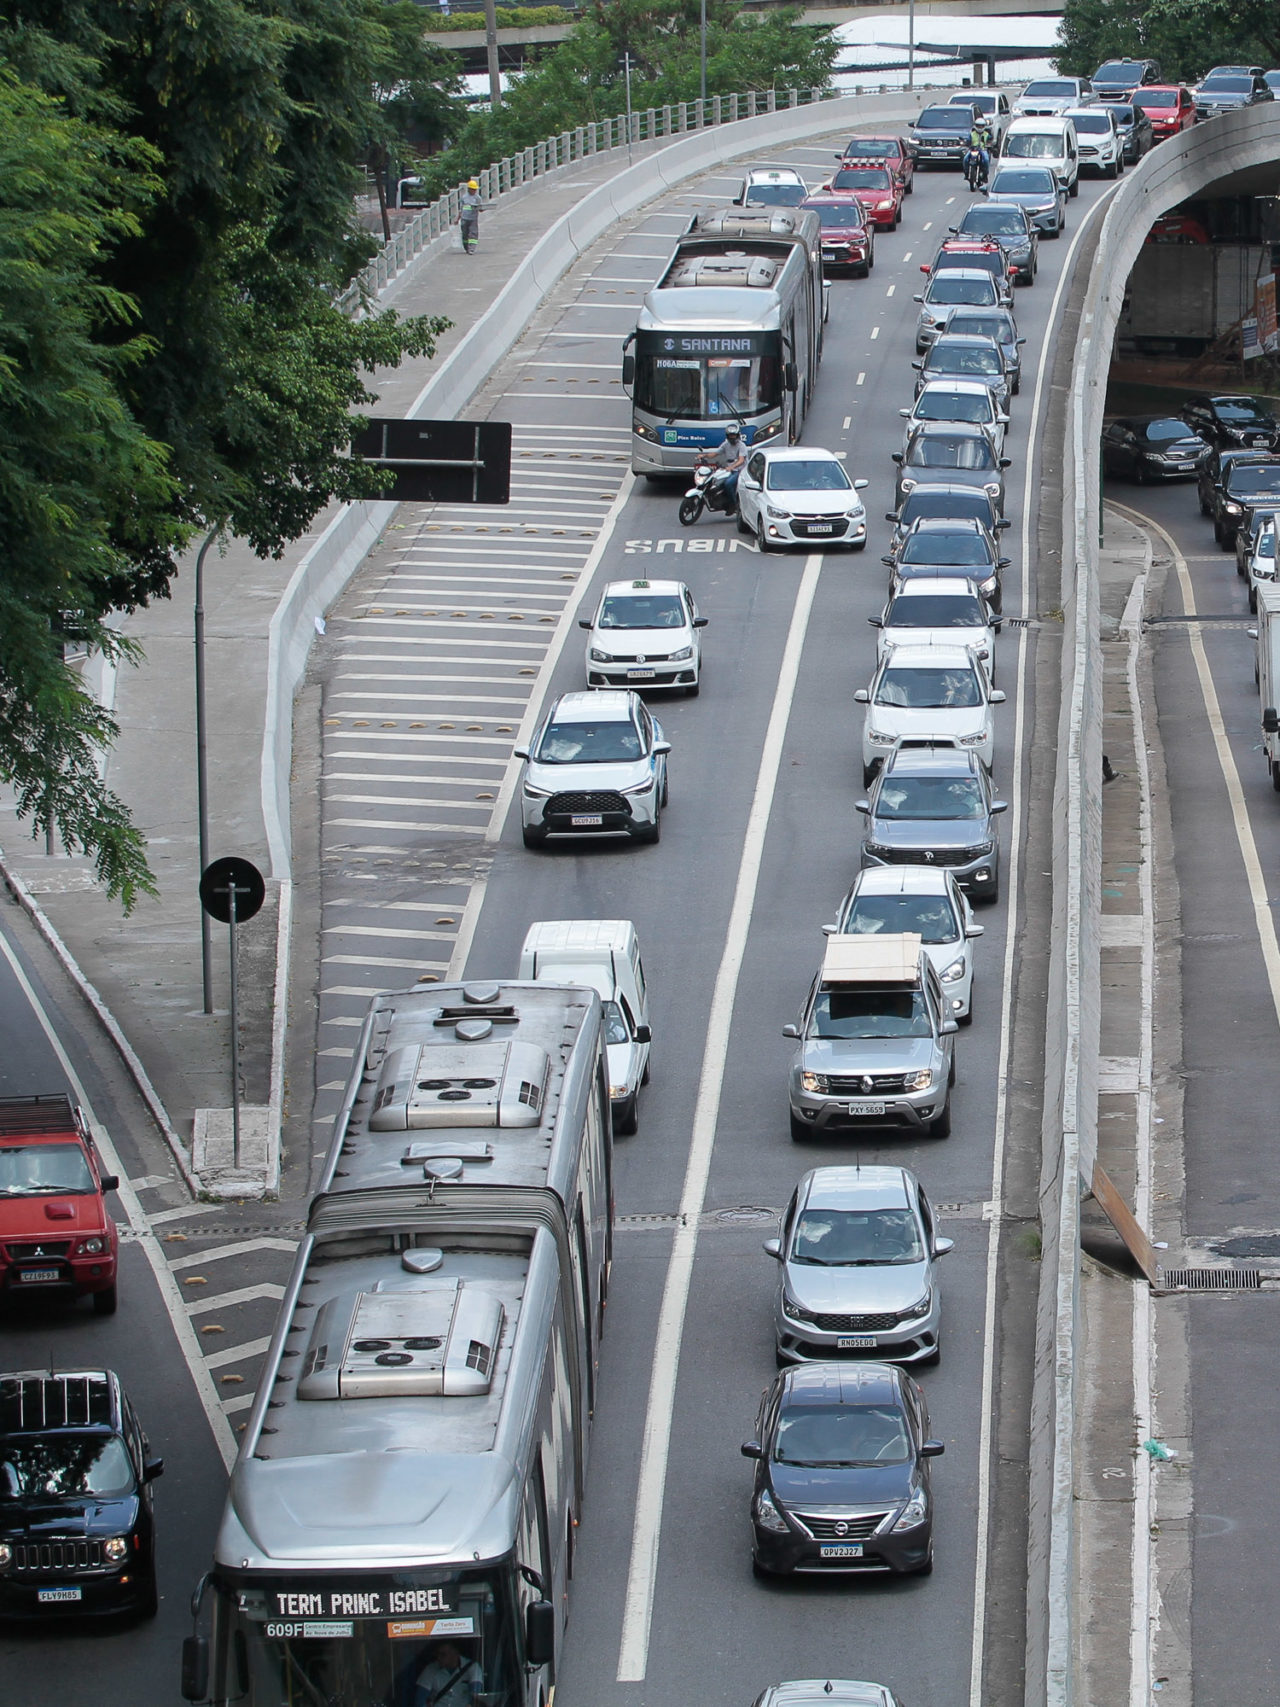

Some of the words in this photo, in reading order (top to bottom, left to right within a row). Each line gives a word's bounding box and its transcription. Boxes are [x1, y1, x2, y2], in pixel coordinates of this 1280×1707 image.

[681, 338, 751, 351] SANTANA
[42, 1592, 78, 1600] FLY9H85
[277, 1593, 326, 1615] TERM.
[390, 1589, 450, 1613] ISABEL
[267, 1623, 303, 1637] 609F
